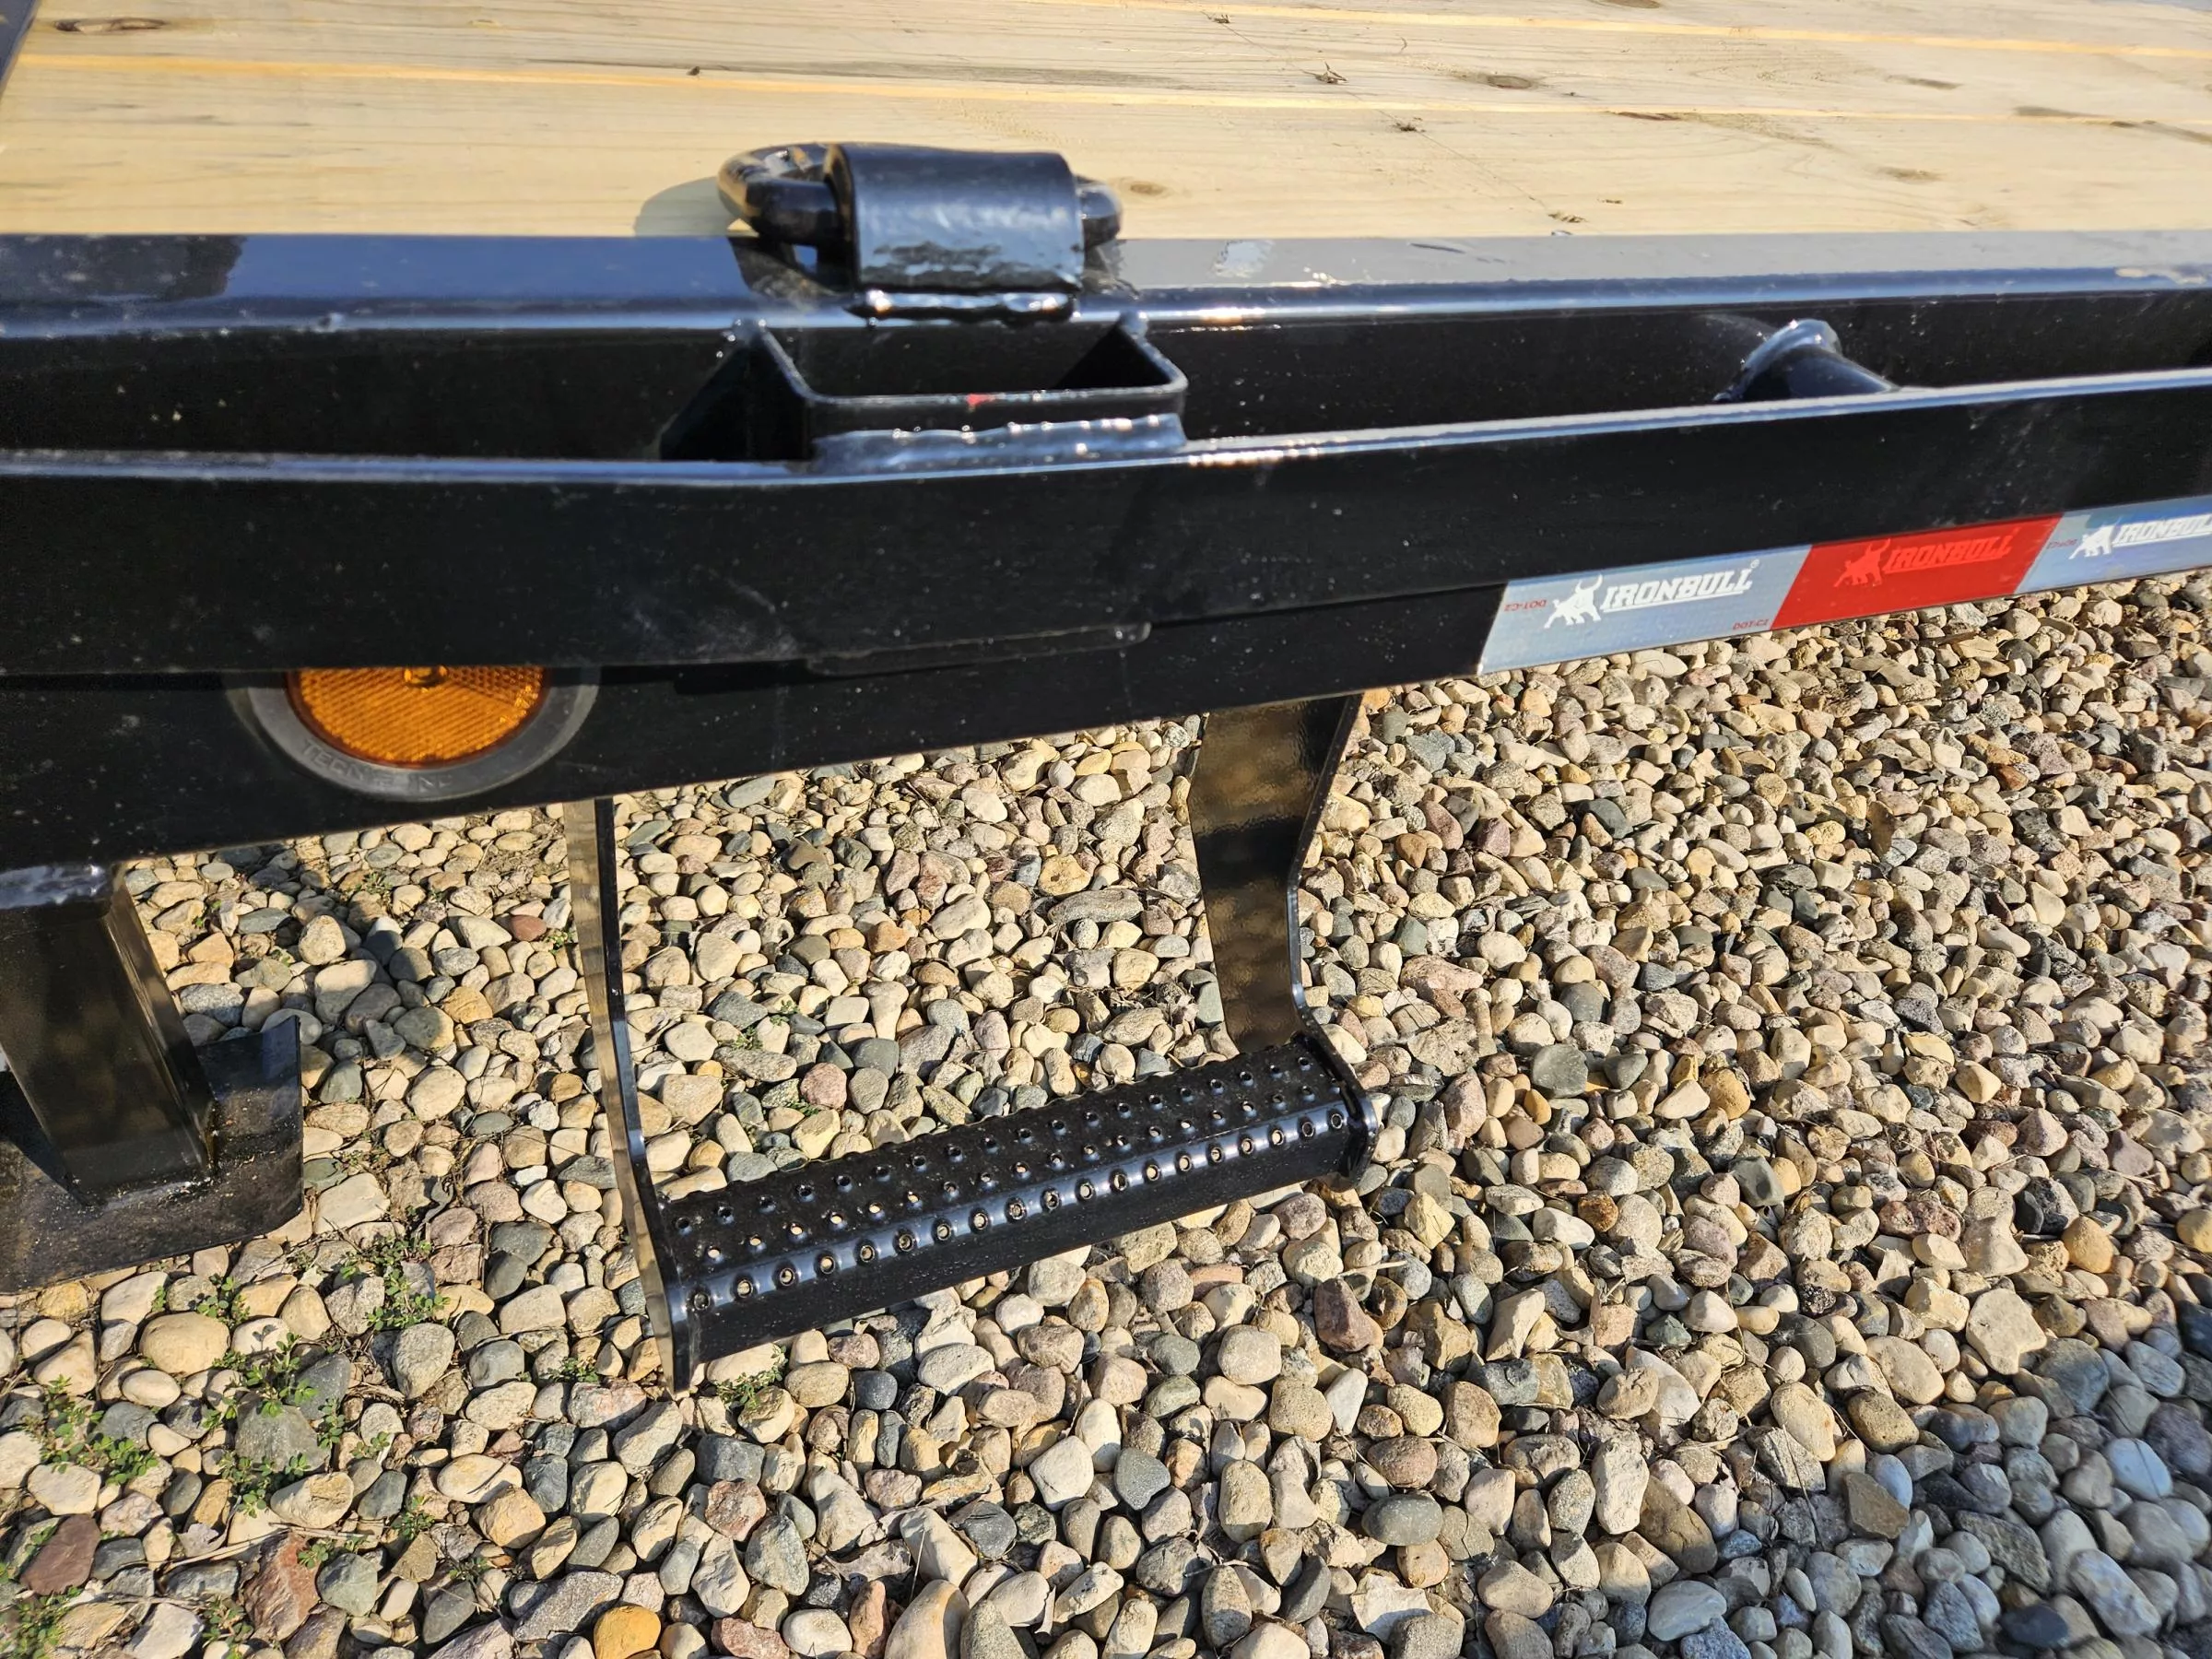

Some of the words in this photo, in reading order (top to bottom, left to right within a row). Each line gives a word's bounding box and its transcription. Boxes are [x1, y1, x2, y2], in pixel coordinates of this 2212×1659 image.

[2112, 512, 2212, 547] IRONBUL
[1883, 538, 2013, 571] IRONBULL
[1601, 567, 1754, 612] IRONBULL
